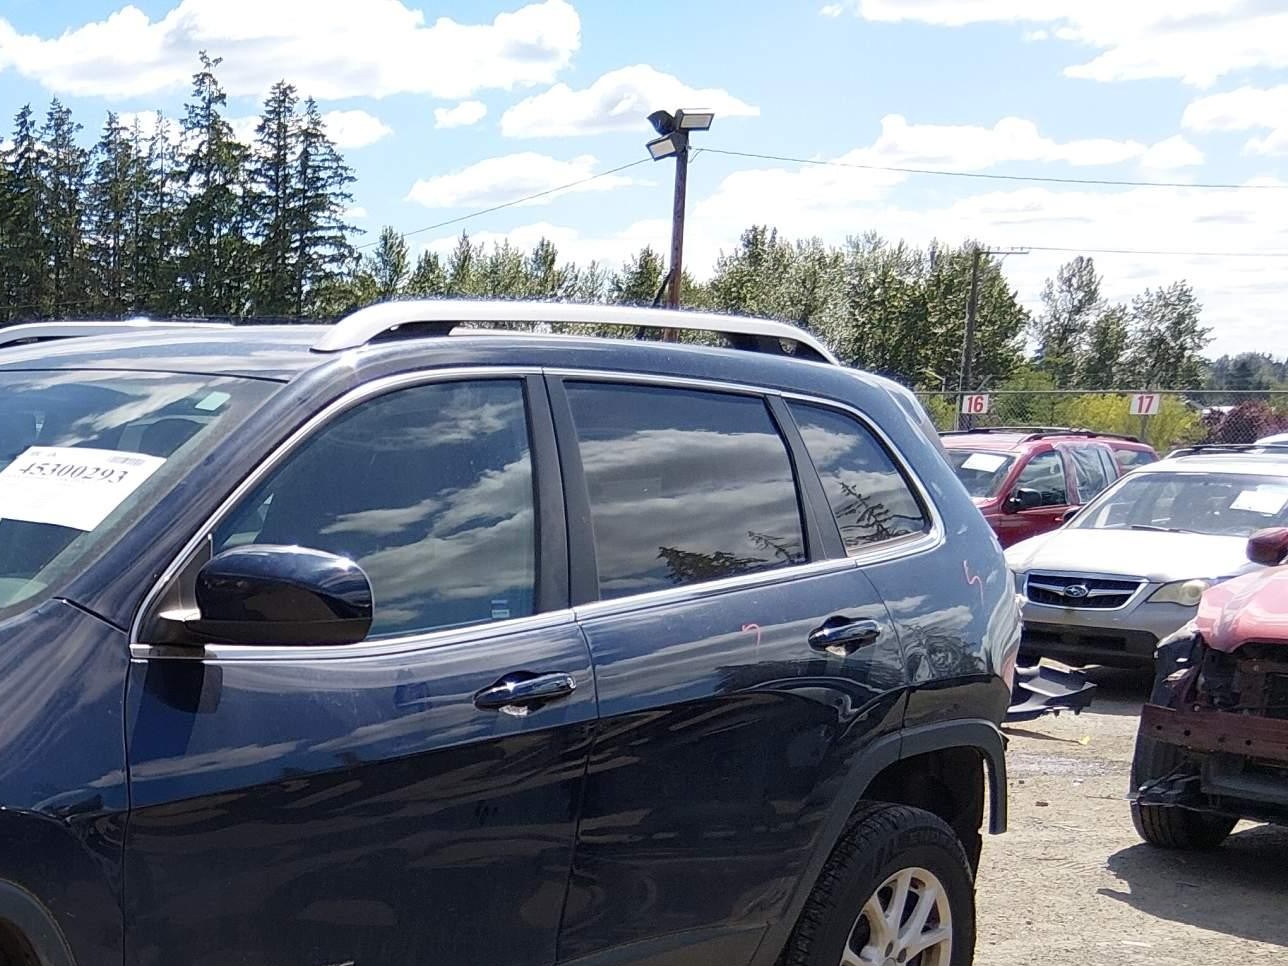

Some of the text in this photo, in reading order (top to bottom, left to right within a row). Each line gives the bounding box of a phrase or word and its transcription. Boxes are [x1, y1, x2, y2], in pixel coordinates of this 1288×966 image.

[967, 395, 984, 413] 16
[1138, 395, 1154, 413] 17
[20, 461, 129, 483] 45300293
